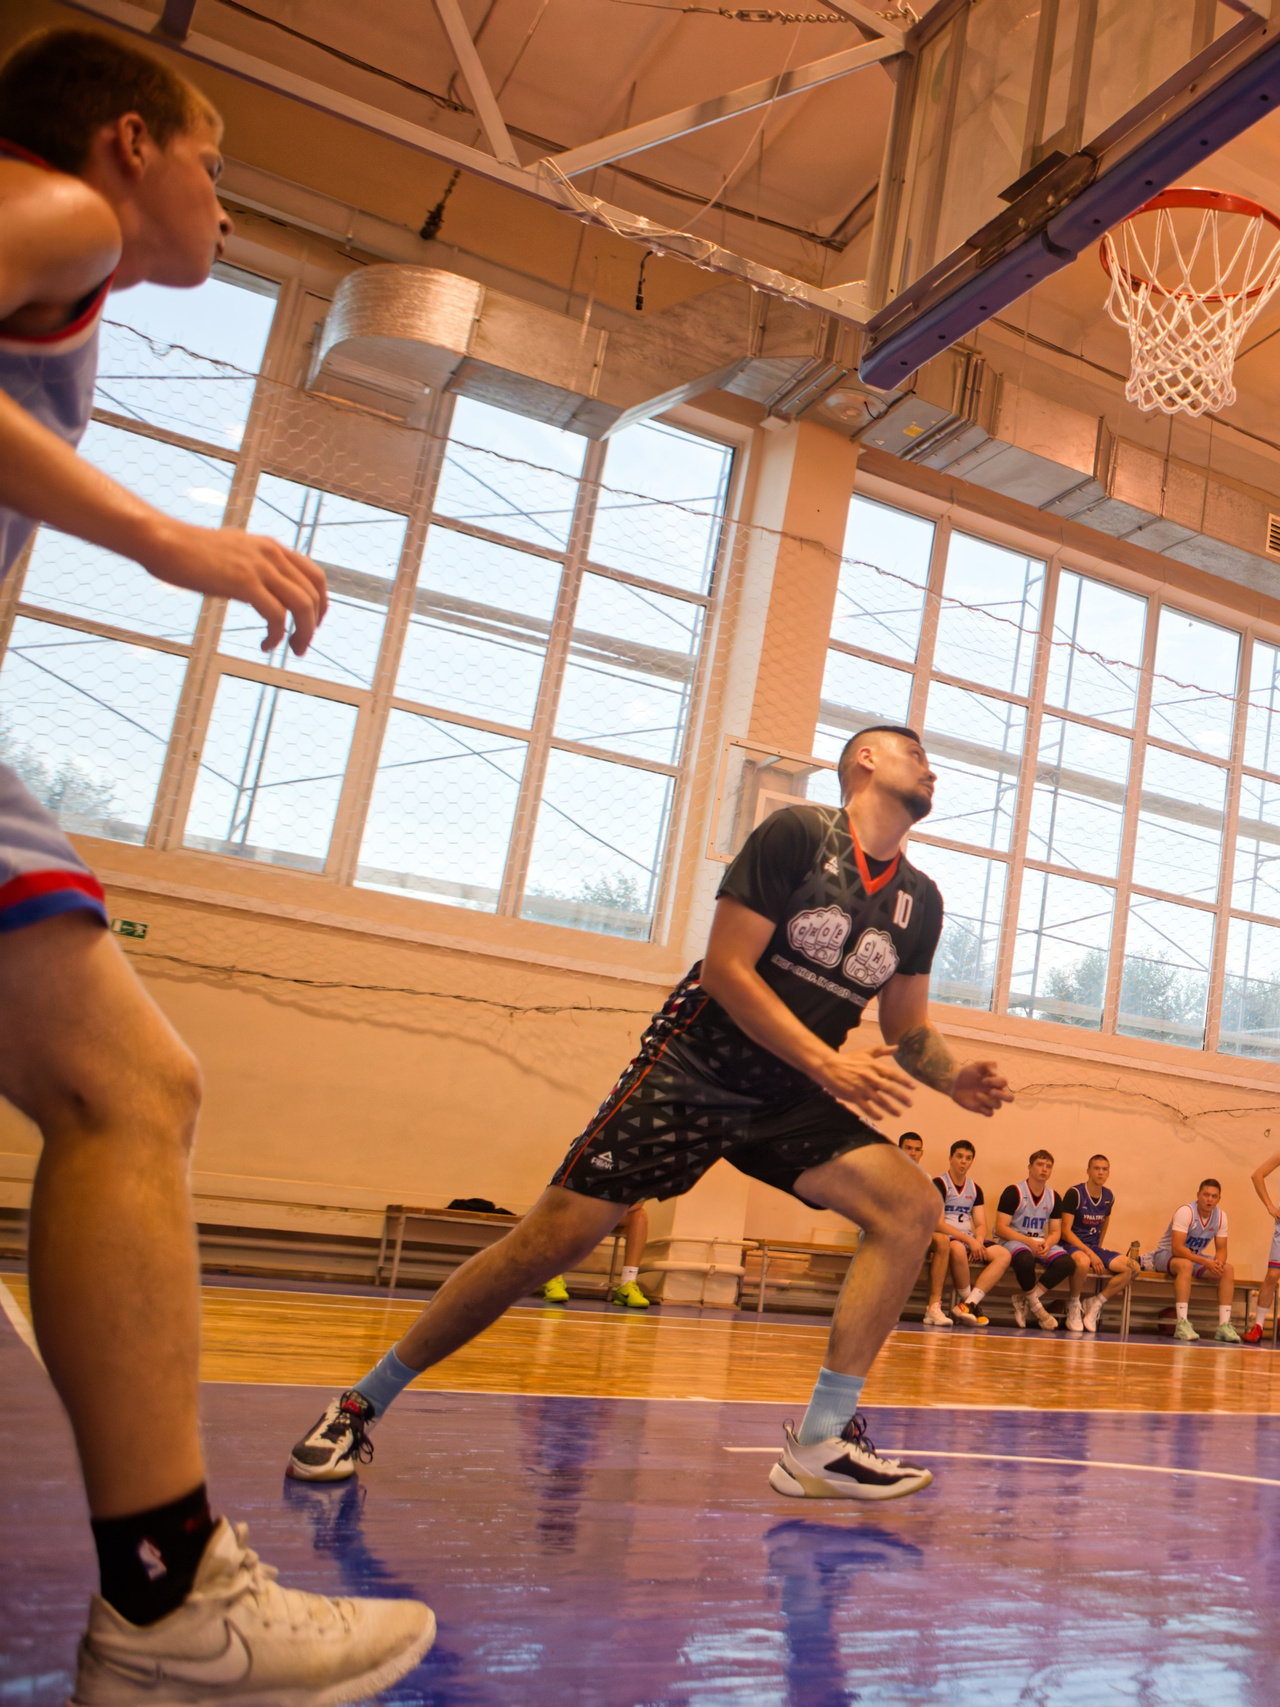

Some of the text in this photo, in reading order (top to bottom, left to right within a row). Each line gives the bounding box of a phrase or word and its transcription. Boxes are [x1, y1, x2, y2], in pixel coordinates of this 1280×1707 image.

[893, 889, 914, 930] 10
[798, 926, 844, 939] CHOP
[864, 941, 888, 975] CHO
